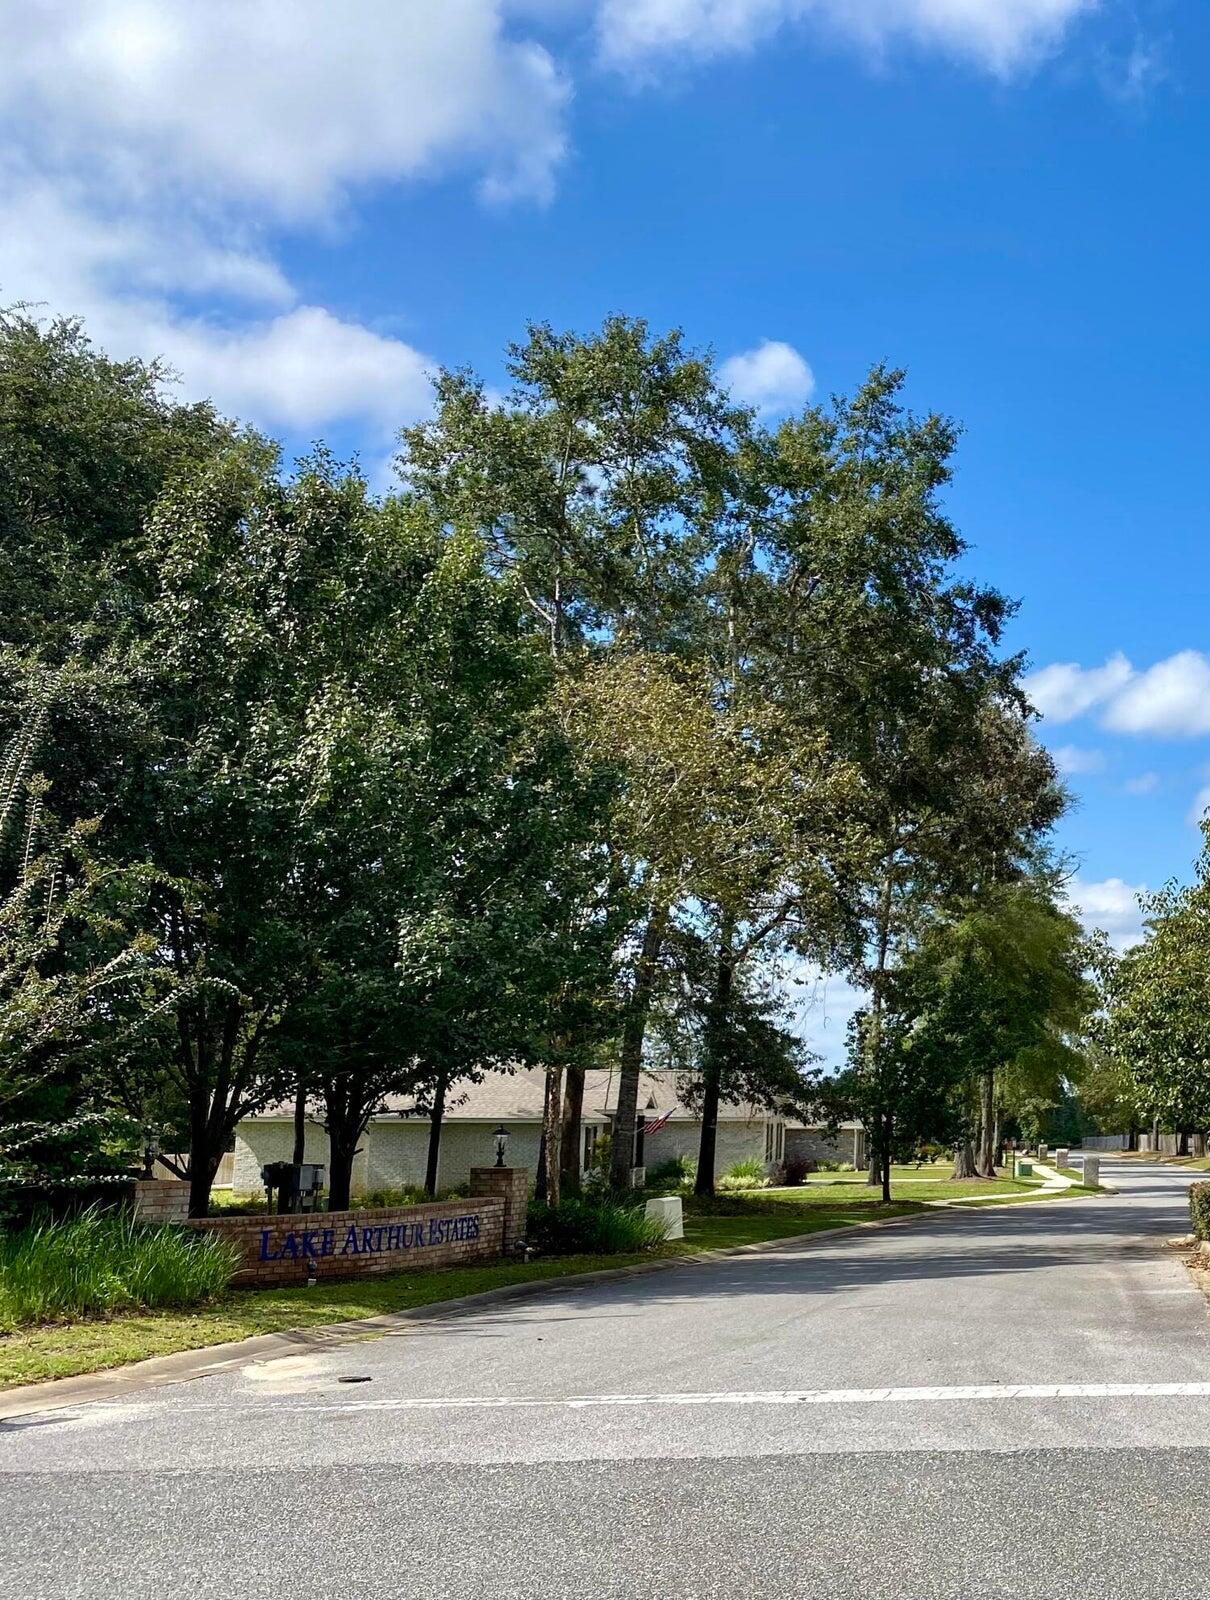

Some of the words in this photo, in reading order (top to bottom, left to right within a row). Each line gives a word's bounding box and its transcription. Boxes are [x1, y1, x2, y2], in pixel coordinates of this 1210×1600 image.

[259, 1230, 335, 1261] LAKE
[342, 1223, 424, 1255] ARTHUR
[429, 1215, 480, 1245] ESTATES
